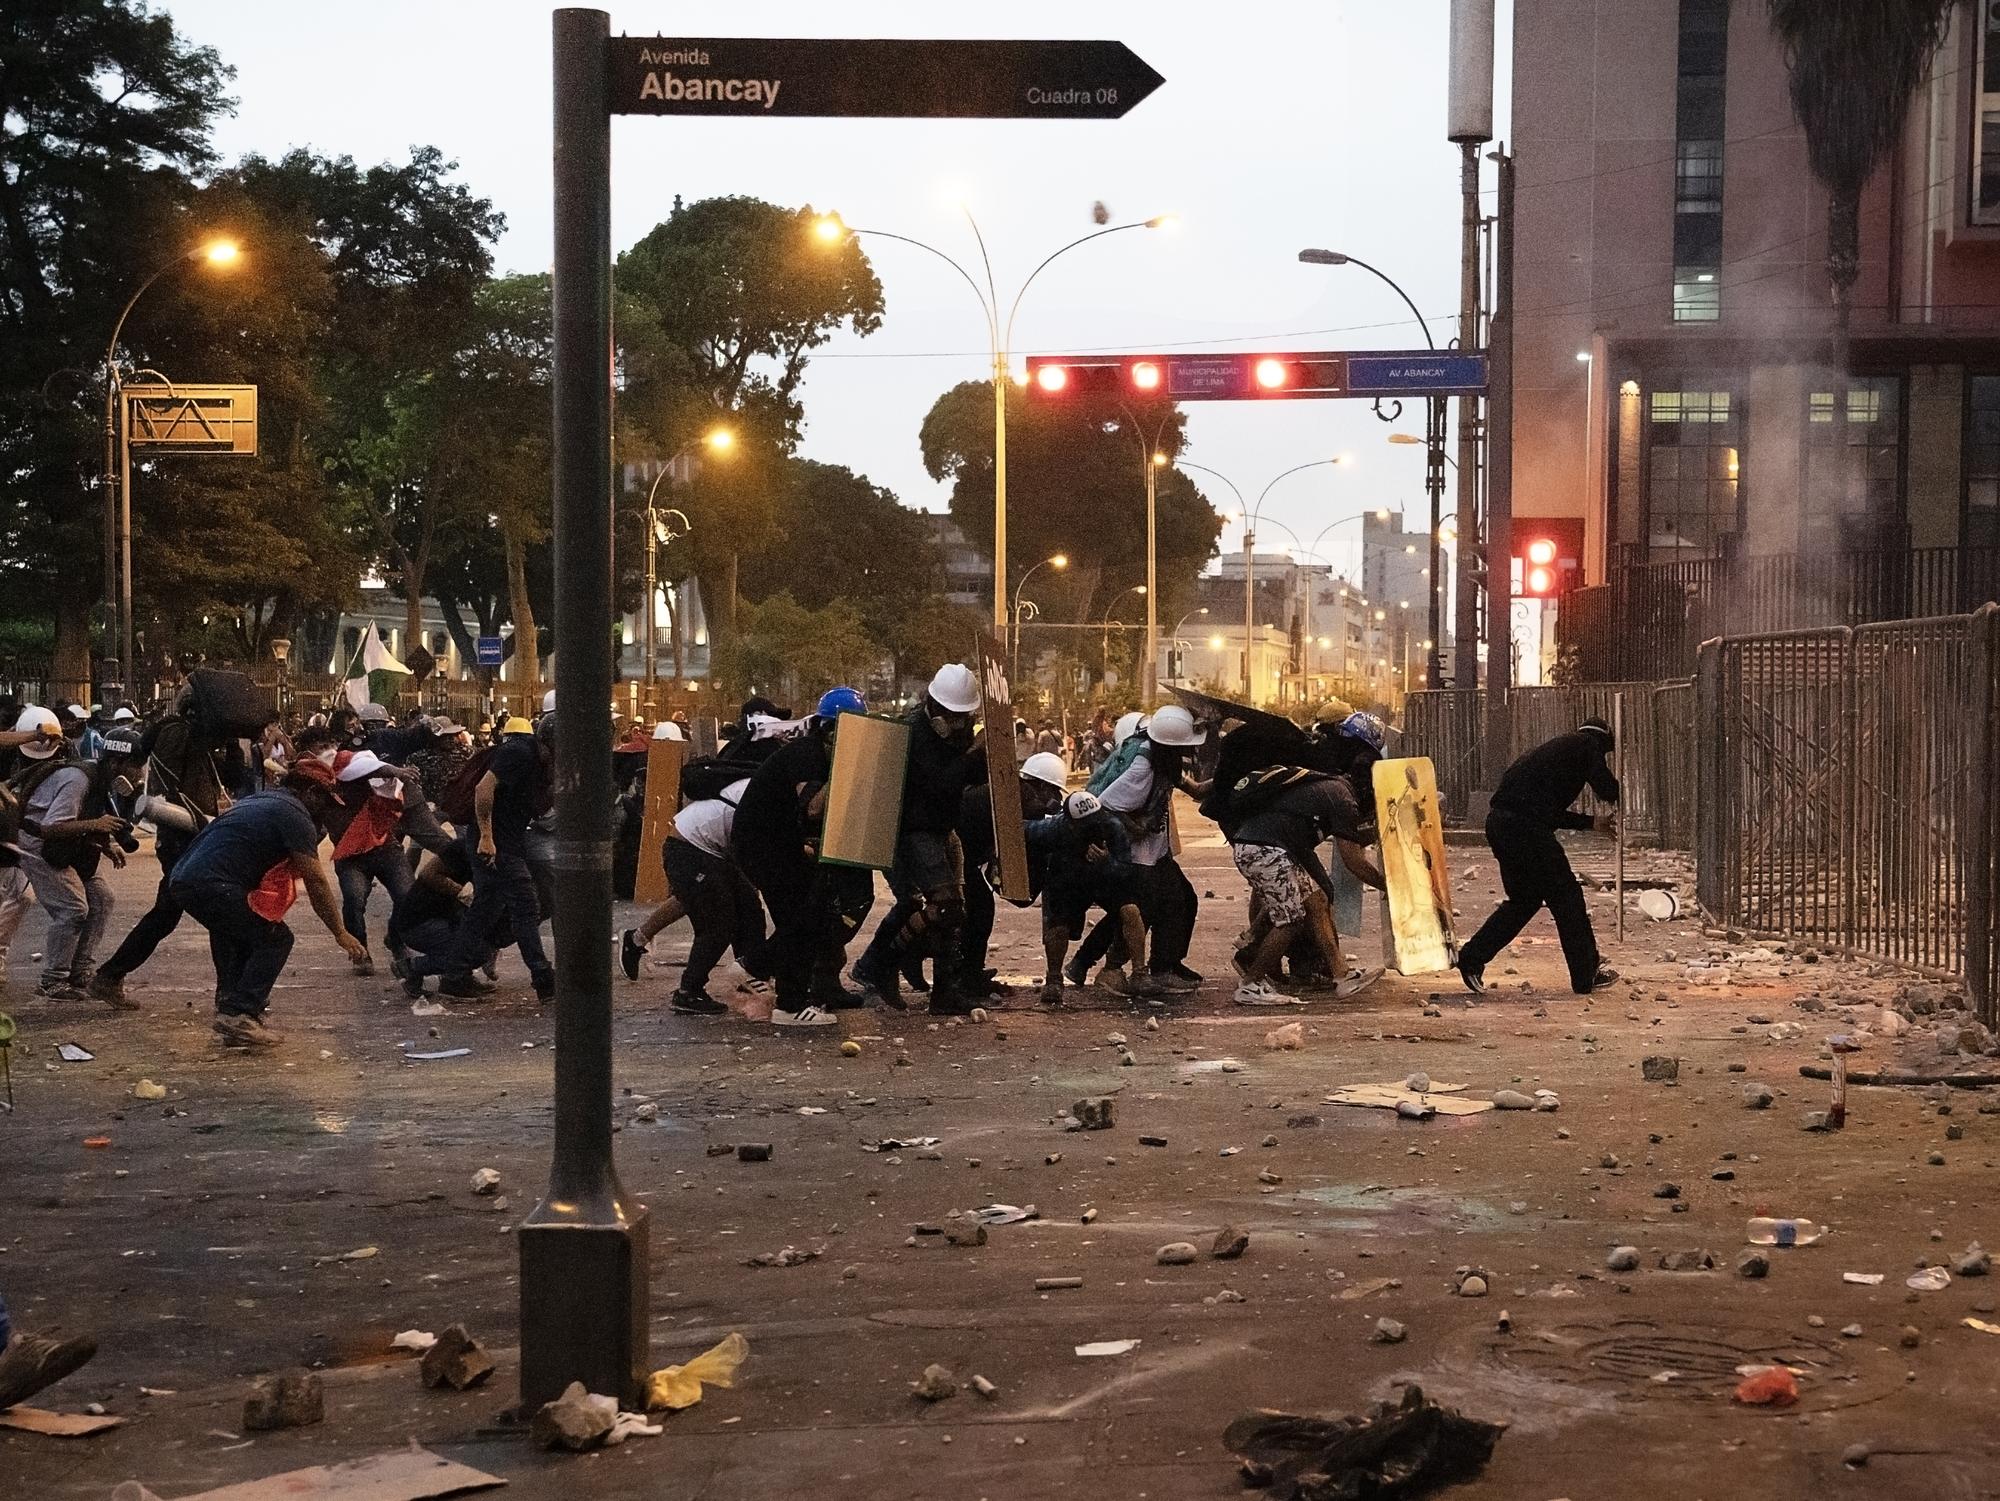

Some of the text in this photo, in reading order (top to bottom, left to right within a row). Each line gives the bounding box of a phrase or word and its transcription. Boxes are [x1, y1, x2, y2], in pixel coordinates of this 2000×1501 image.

[640, 48, 709, 65] Avenida
[640, 71, 781, 109] Abancay
[1027, 86, 1118, 105] Cuadra 08
[1178, 367, 1239, 375] MUNICIPALIDAD
[1404, 369, 1446, 377] ABANCAY
[1192, 378, 1225, 386] DE LIMA
[103, 740, 132, 753] PRENSA
